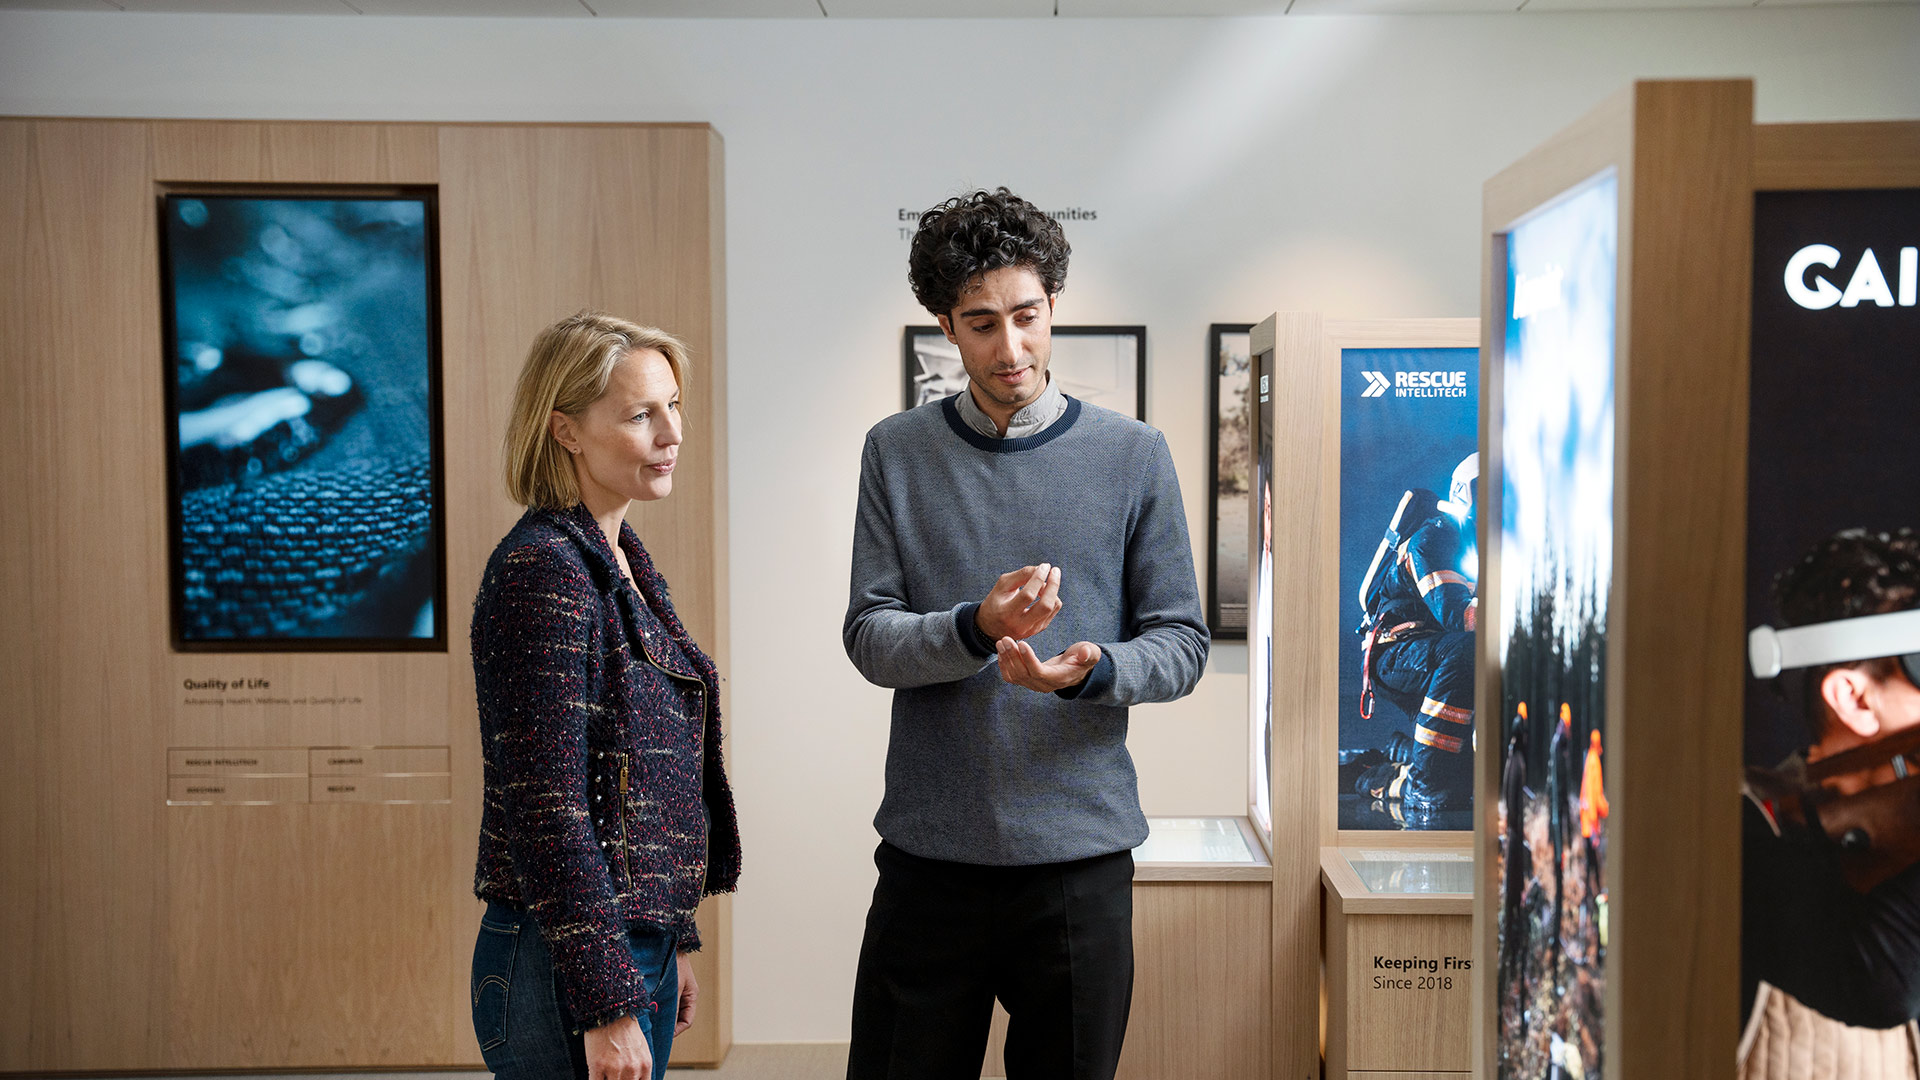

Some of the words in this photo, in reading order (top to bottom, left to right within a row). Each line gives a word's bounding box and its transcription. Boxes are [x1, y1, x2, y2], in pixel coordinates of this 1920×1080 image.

[1047, 206, 1098, 221] unities
[1395, 371, 1467, 388] RESCUE
[1395, 388, 1467, 398] INTELLITECH
[183, 678, 228, 692] Quality
[231, 678, 244, 690] of
[247, 678, 270, 690] Life
[1374, 956, 1438, 973] Keeping
[1444, 956, 1475, 970] Firs
[1373, 975, 1413, 989] Since
[1417, 976, 1453, 990] 2018
